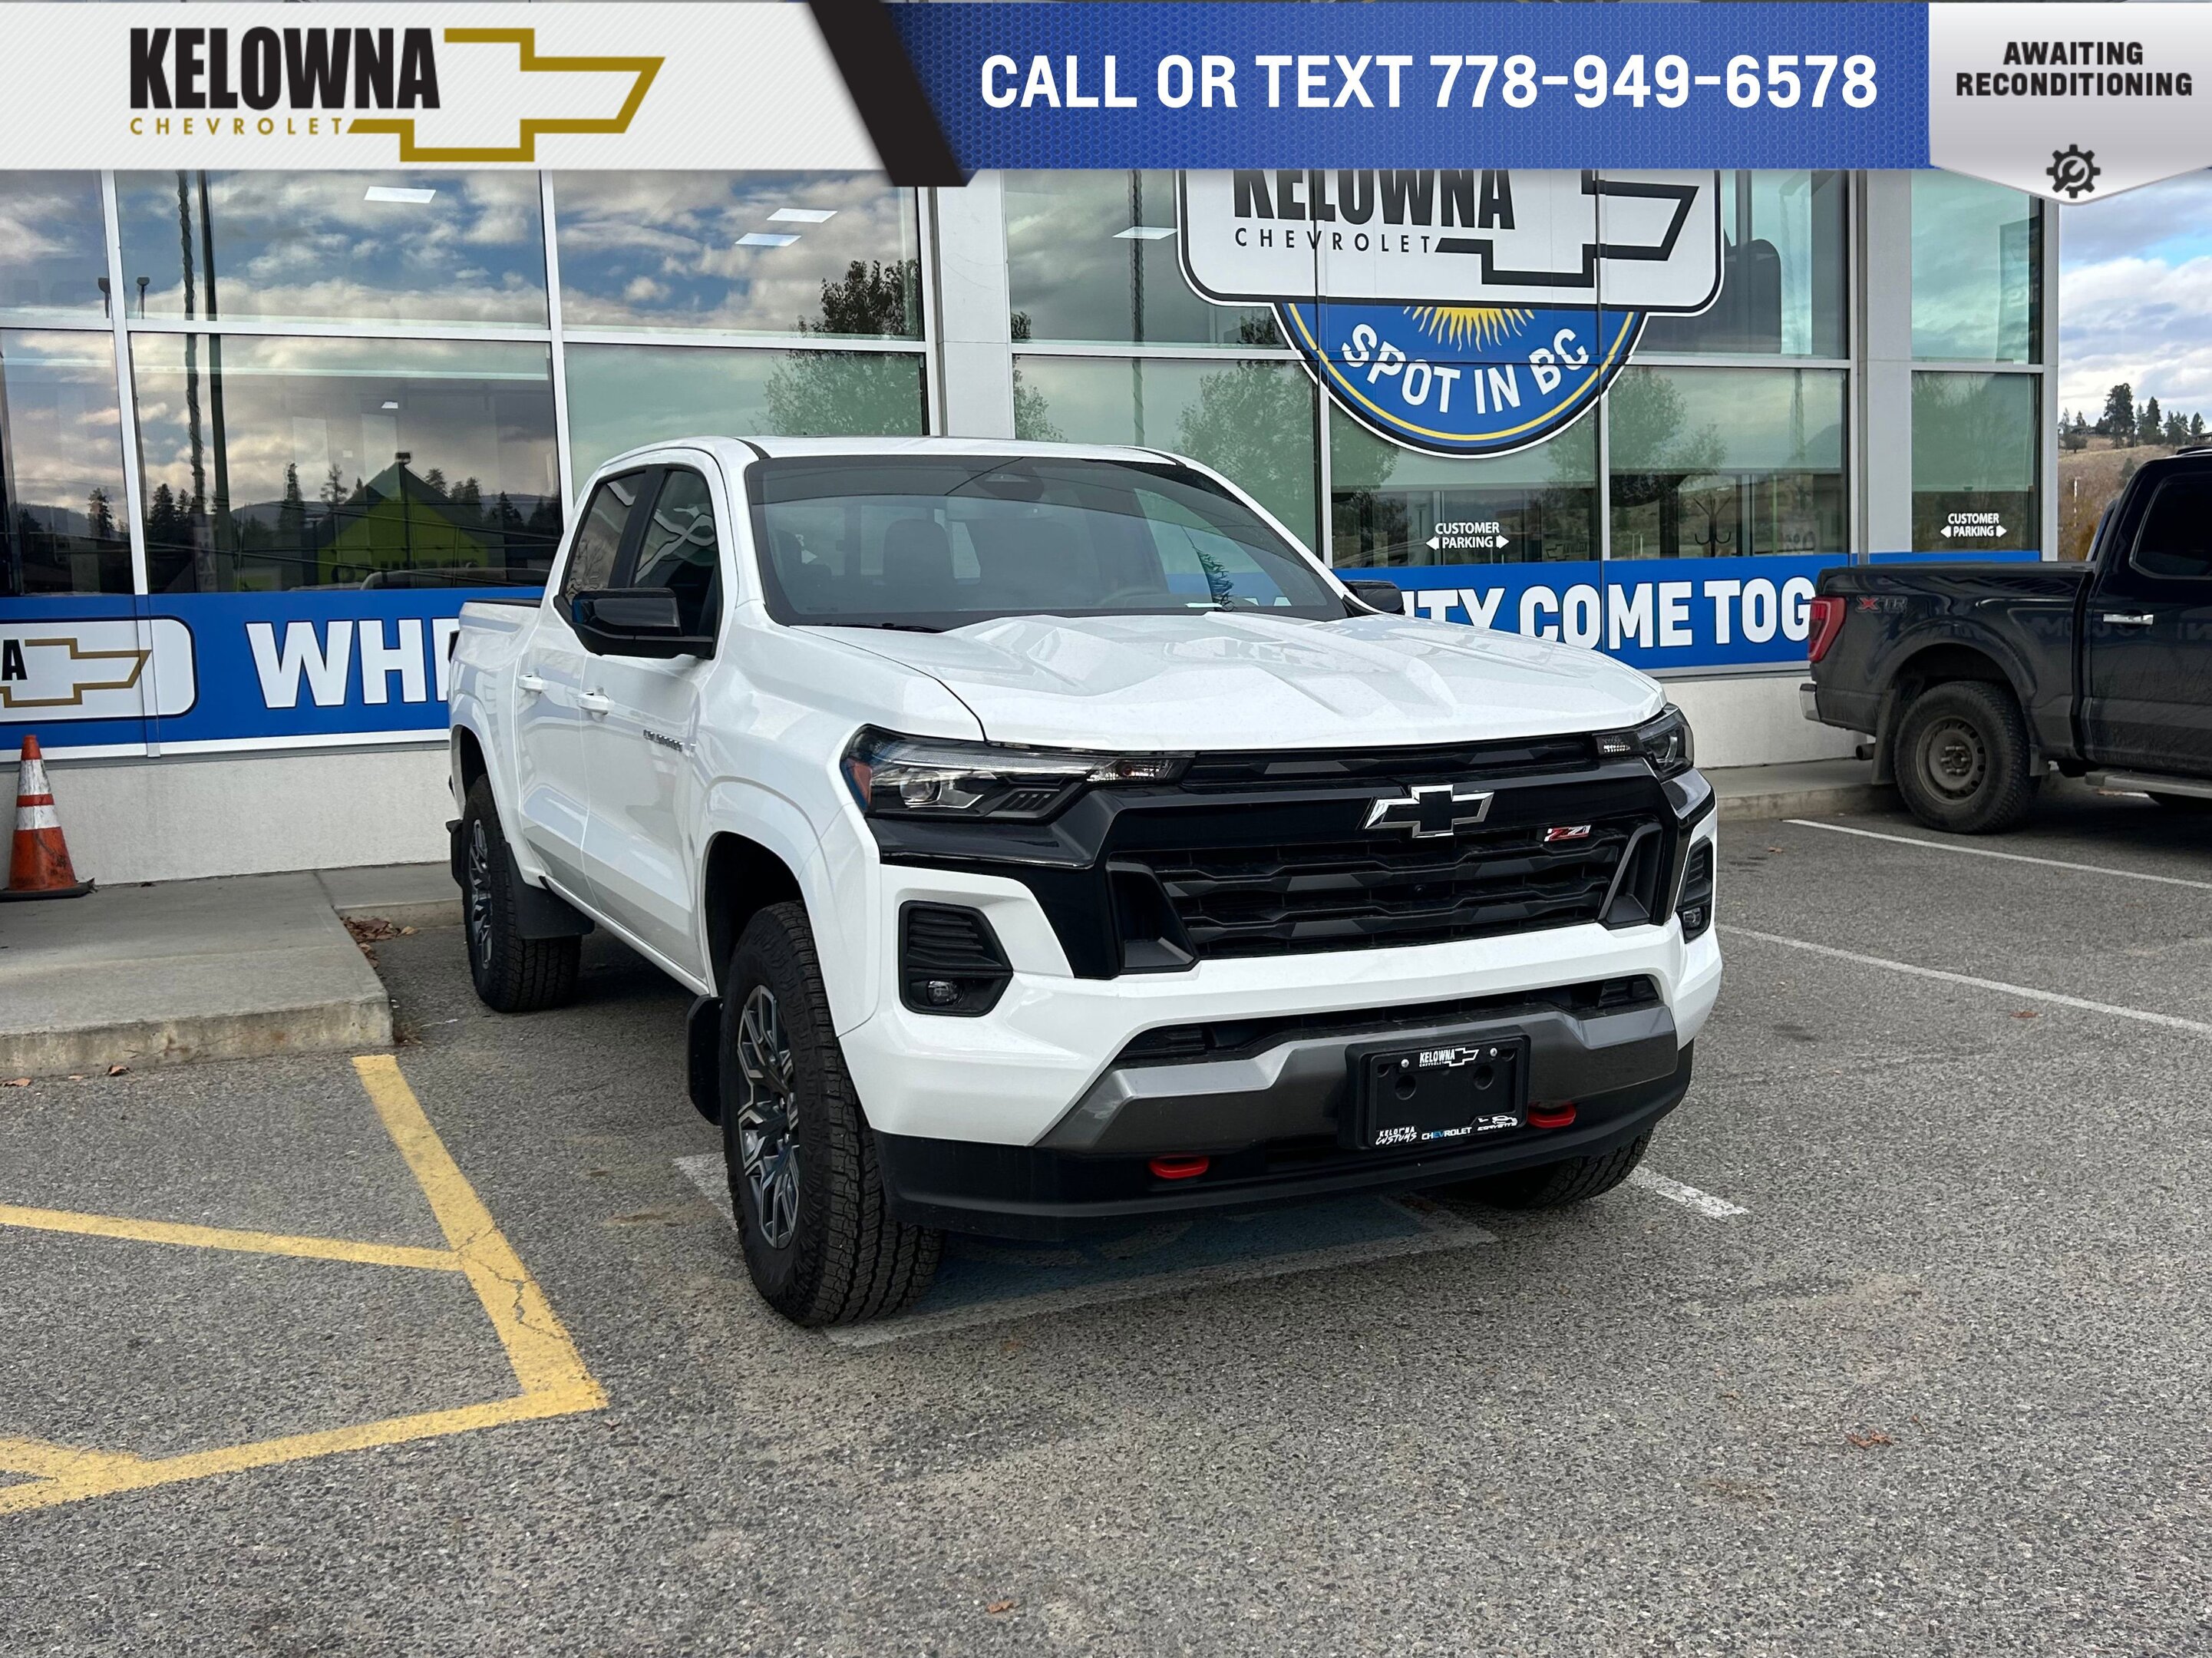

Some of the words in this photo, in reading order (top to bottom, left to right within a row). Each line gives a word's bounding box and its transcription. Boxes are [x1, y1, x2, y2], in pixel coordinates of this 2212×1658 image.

[1233, 169, 1515, 230] KELOWNA
[1235, 227, 1430, 253] CHEVROLET
[1342, 323, 1461, 414] SPOT
[1474, 364, 1521, 414] IN
[1528, 328, 1590, 396] BC
[1948, 513, 1999, 524] CUSTOMER
[1434, 521, 1501, 535] CUSTOMER
[1953, 525, 1995, 537] PARKING
[1441, 536, 1494, 550] PARKING
[1519, 581, 1692, 650] COME
[1544, 824, 1591, 842] Z71
[1419, 1049, 1455, 1064] KELOWNA
[1421, 1127, 1473, 1141] CHEVROLET
